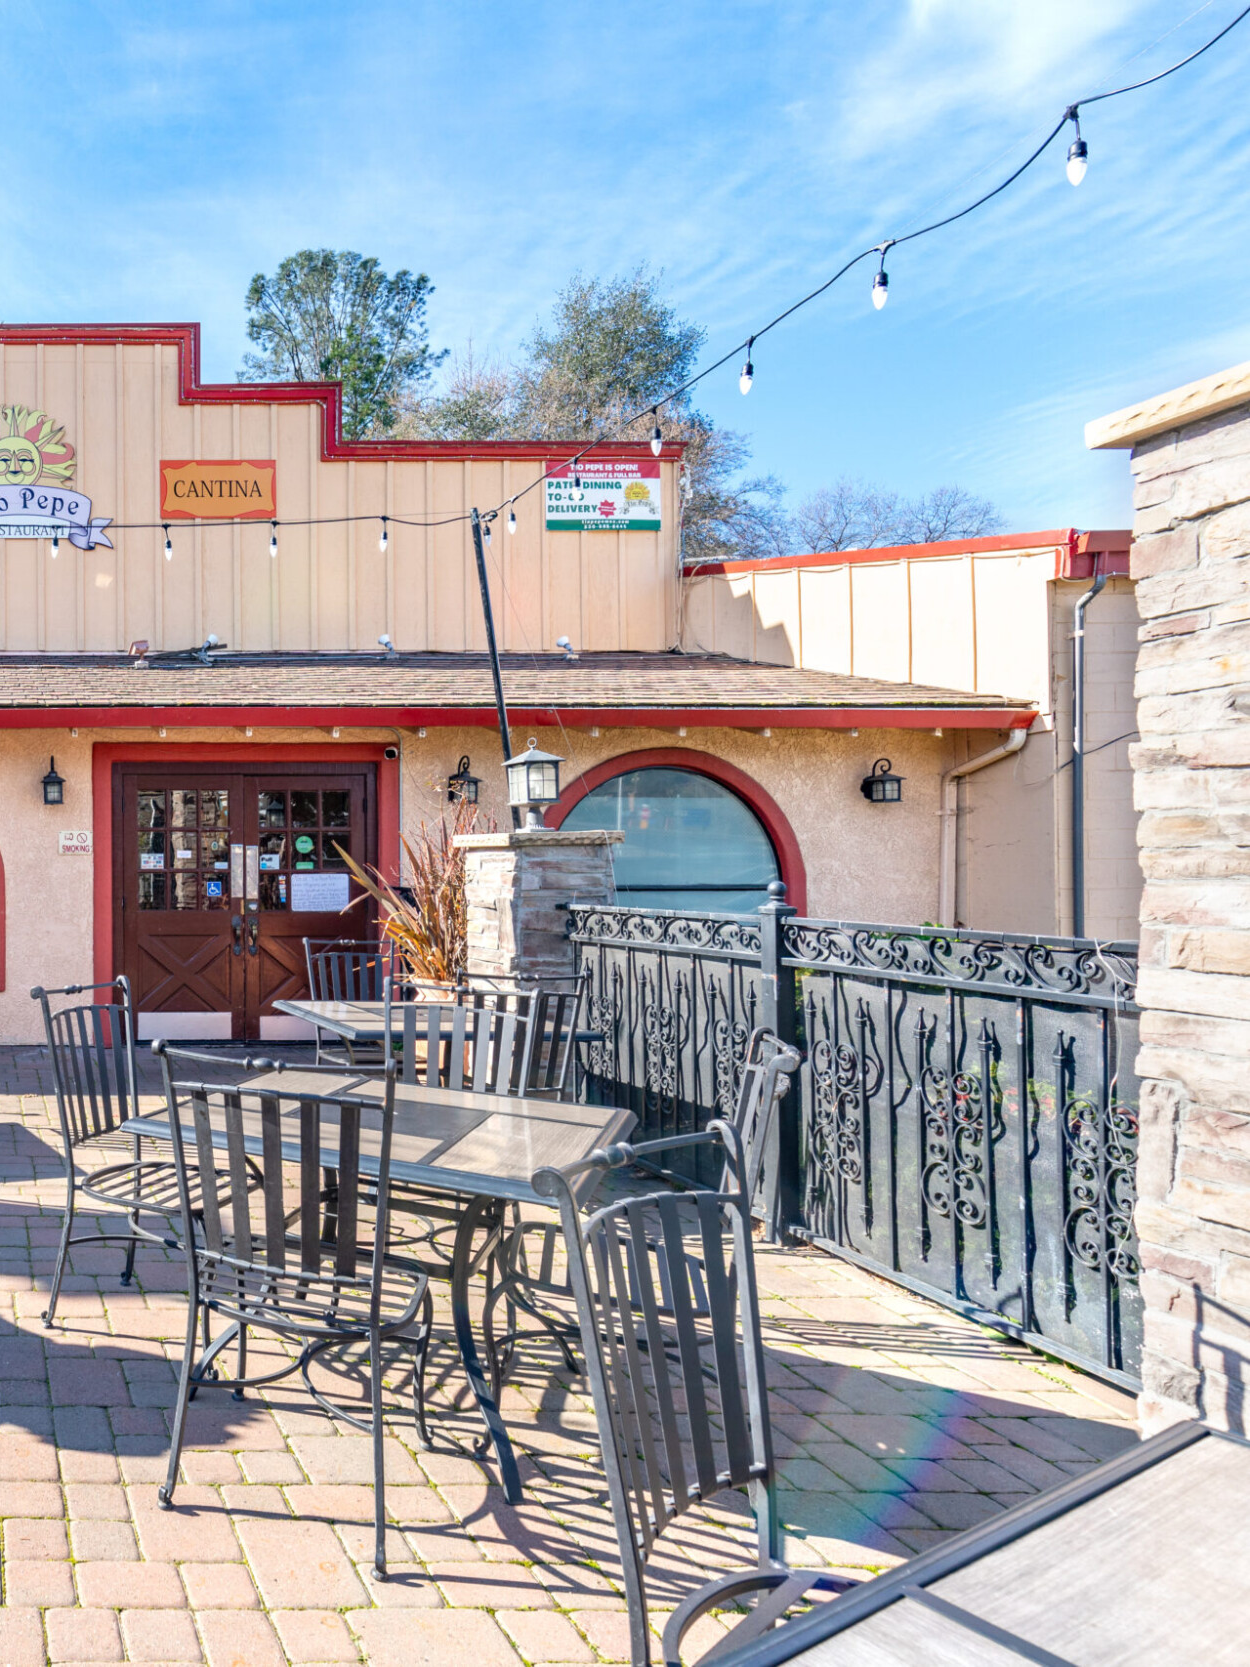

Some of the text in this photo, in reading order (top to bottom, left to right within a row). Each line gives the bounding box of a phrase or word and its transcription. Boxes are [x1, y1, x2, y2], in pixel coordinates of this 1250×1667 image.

[173, 480, 262, 498] CANTINA
[547, 481, 622, 490] PATI DINING
[19, 487, 79, 516] Pepe
[547, 505, 598, 513] DELIVERY
[62, 844, 90, 853] SMOKING
